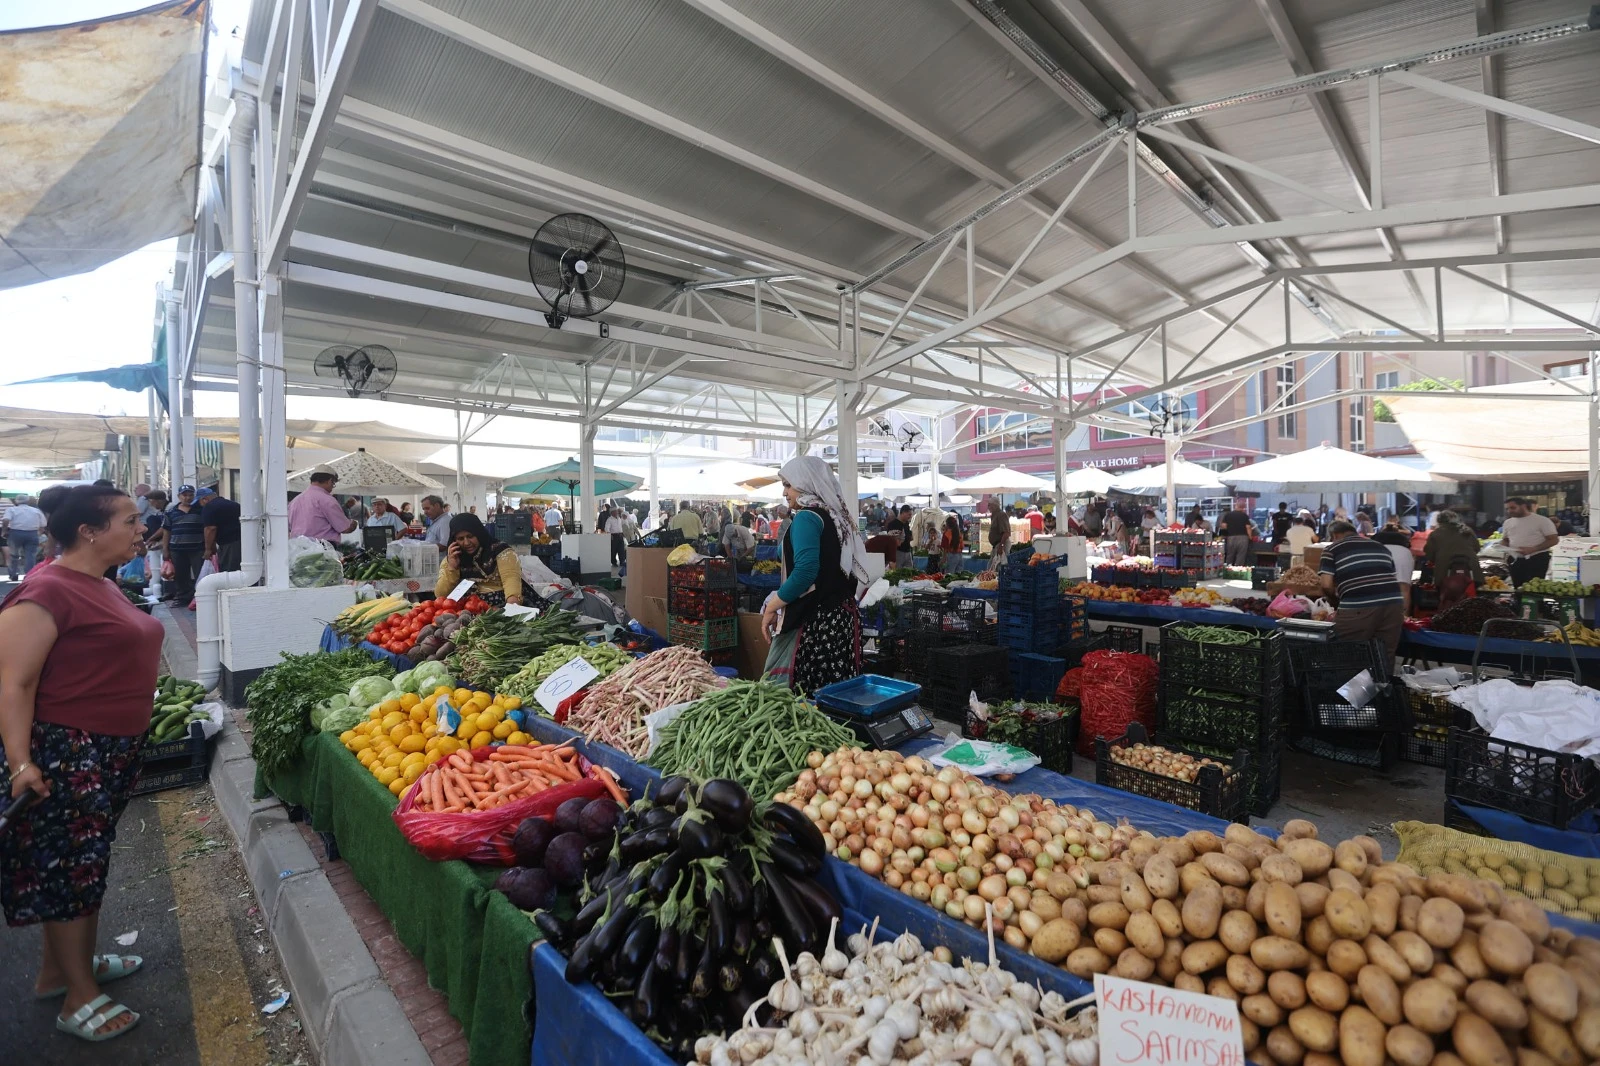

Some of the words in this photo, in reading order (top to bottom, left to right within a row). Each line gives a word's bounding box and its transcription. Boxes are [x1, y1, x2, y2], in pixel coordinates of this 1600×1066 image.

[1082, 460, 1106, 469] KALE
[1108, 457, 1138, 467] HOME
[543, 674, 573, 697] 60
